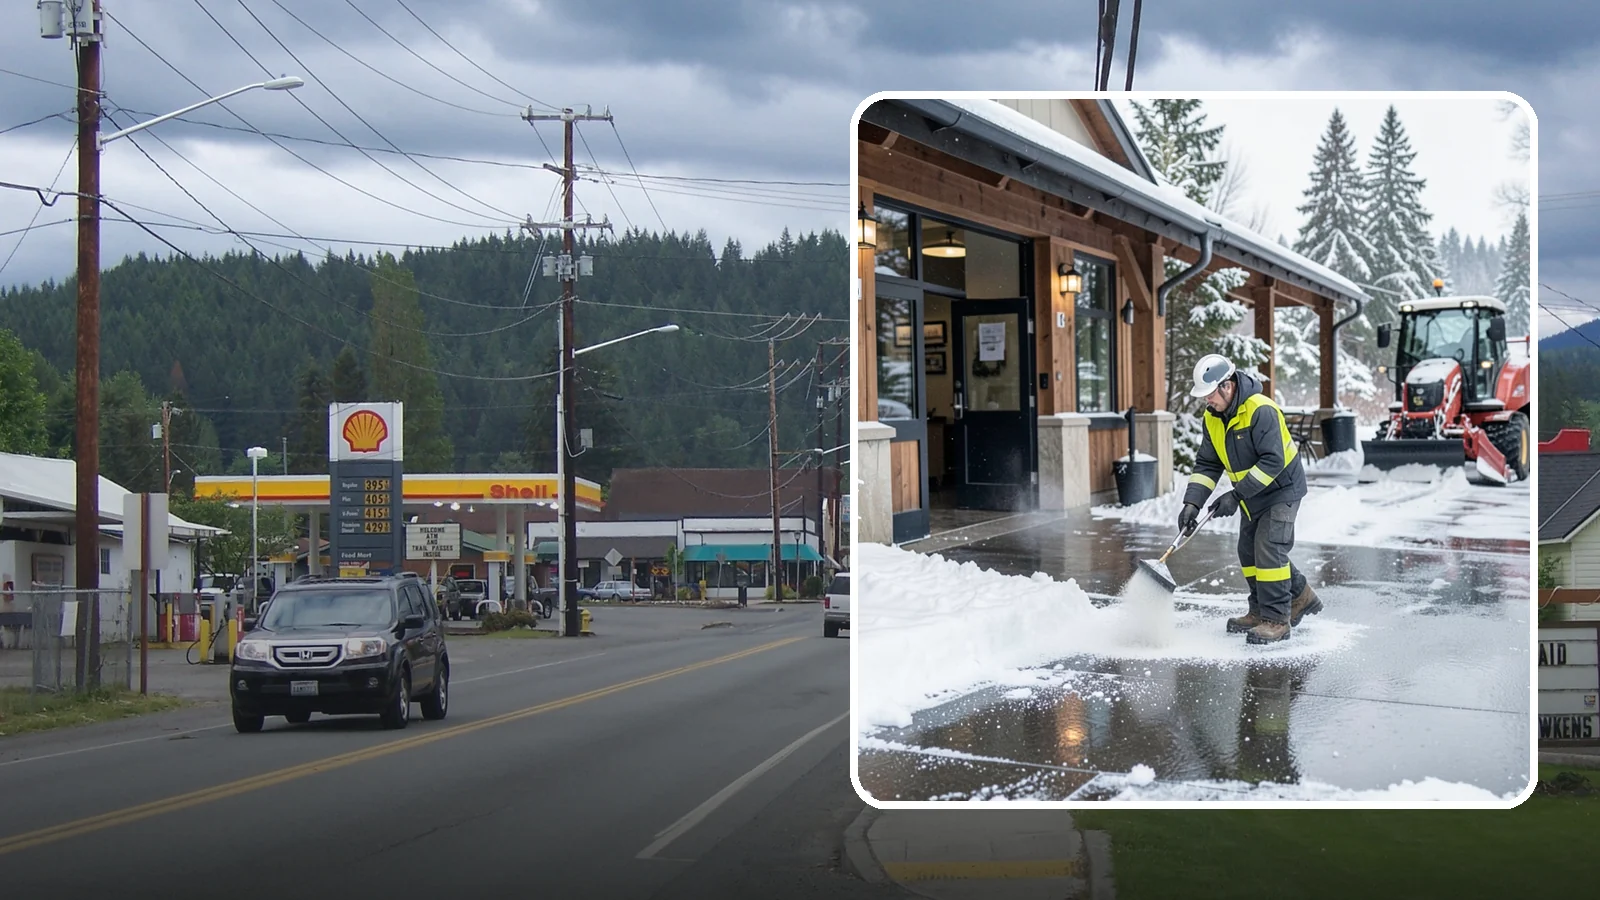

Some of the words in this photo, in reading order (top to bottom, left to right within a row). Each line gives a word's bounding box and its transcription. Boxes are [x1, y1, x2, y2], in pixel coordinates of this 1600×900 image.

[366, 480, 383, 490] 395
[490, 484, 547, 499] Shell
[365, 494, 383, 504] 405
[365, 508, 383, 518] 415
[365, 522, 383, 532] 429
[1538, 643, 1567, 665] AID
[1538, 716, 1592, 739] WKENS
